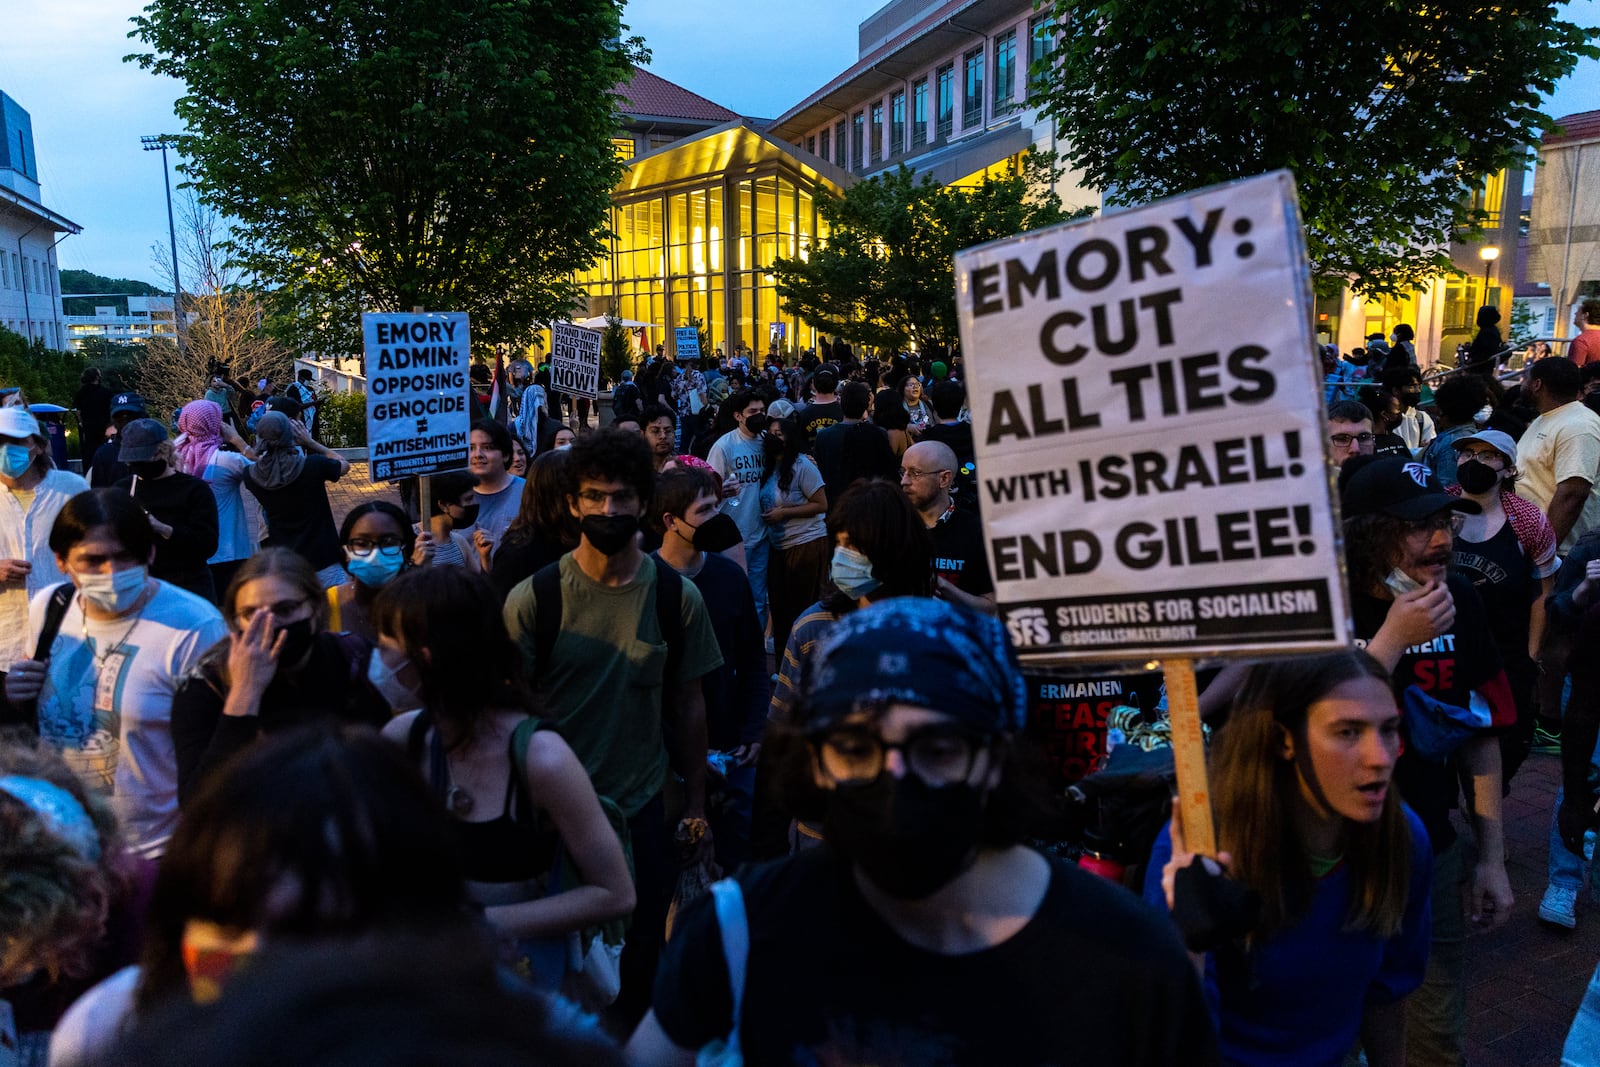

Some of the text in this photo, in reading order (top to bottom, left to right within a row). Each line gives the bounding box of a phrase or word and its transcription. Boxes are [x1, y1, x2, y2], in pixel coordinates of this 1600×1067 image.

[970, 208, 1255, 319] EMORY:
[376, 321, 456, 344] EMORY
[555, 326, 599, 343] STAND WITH
[1039, 288, 1183, 367] CUT
[554, 344, 598, 365] END THE
[555, 335, 599, 353] PALESTINE!
[378, 346, 458, 370] ADMIN:
[553, 359, 597, 376] OCCUPATION
[372, 372, 465, 395] OPPOSING
[554, 366, 595, 392] NOW!
[985, 345, 1278, 446] ALL TIES
[373, 396, 465, 421] GENOCIDE
[375, 432, 467, 456] ANTISEMITISM
[393, 458, 425, 469] STUDENTS
[425, 455, 437, 464] FOR
[985, 430, 1307, 505] WITH ISRAEL!
[991, 504, 1317, 583] END GILEE!
[1056, 590, 1317, 627] STUDENTS FOR SOCIALISM
[1006, 616, 1051, 647] SFS
[1059, 624, 1197, 646] @SOCIALISMATEMORY
